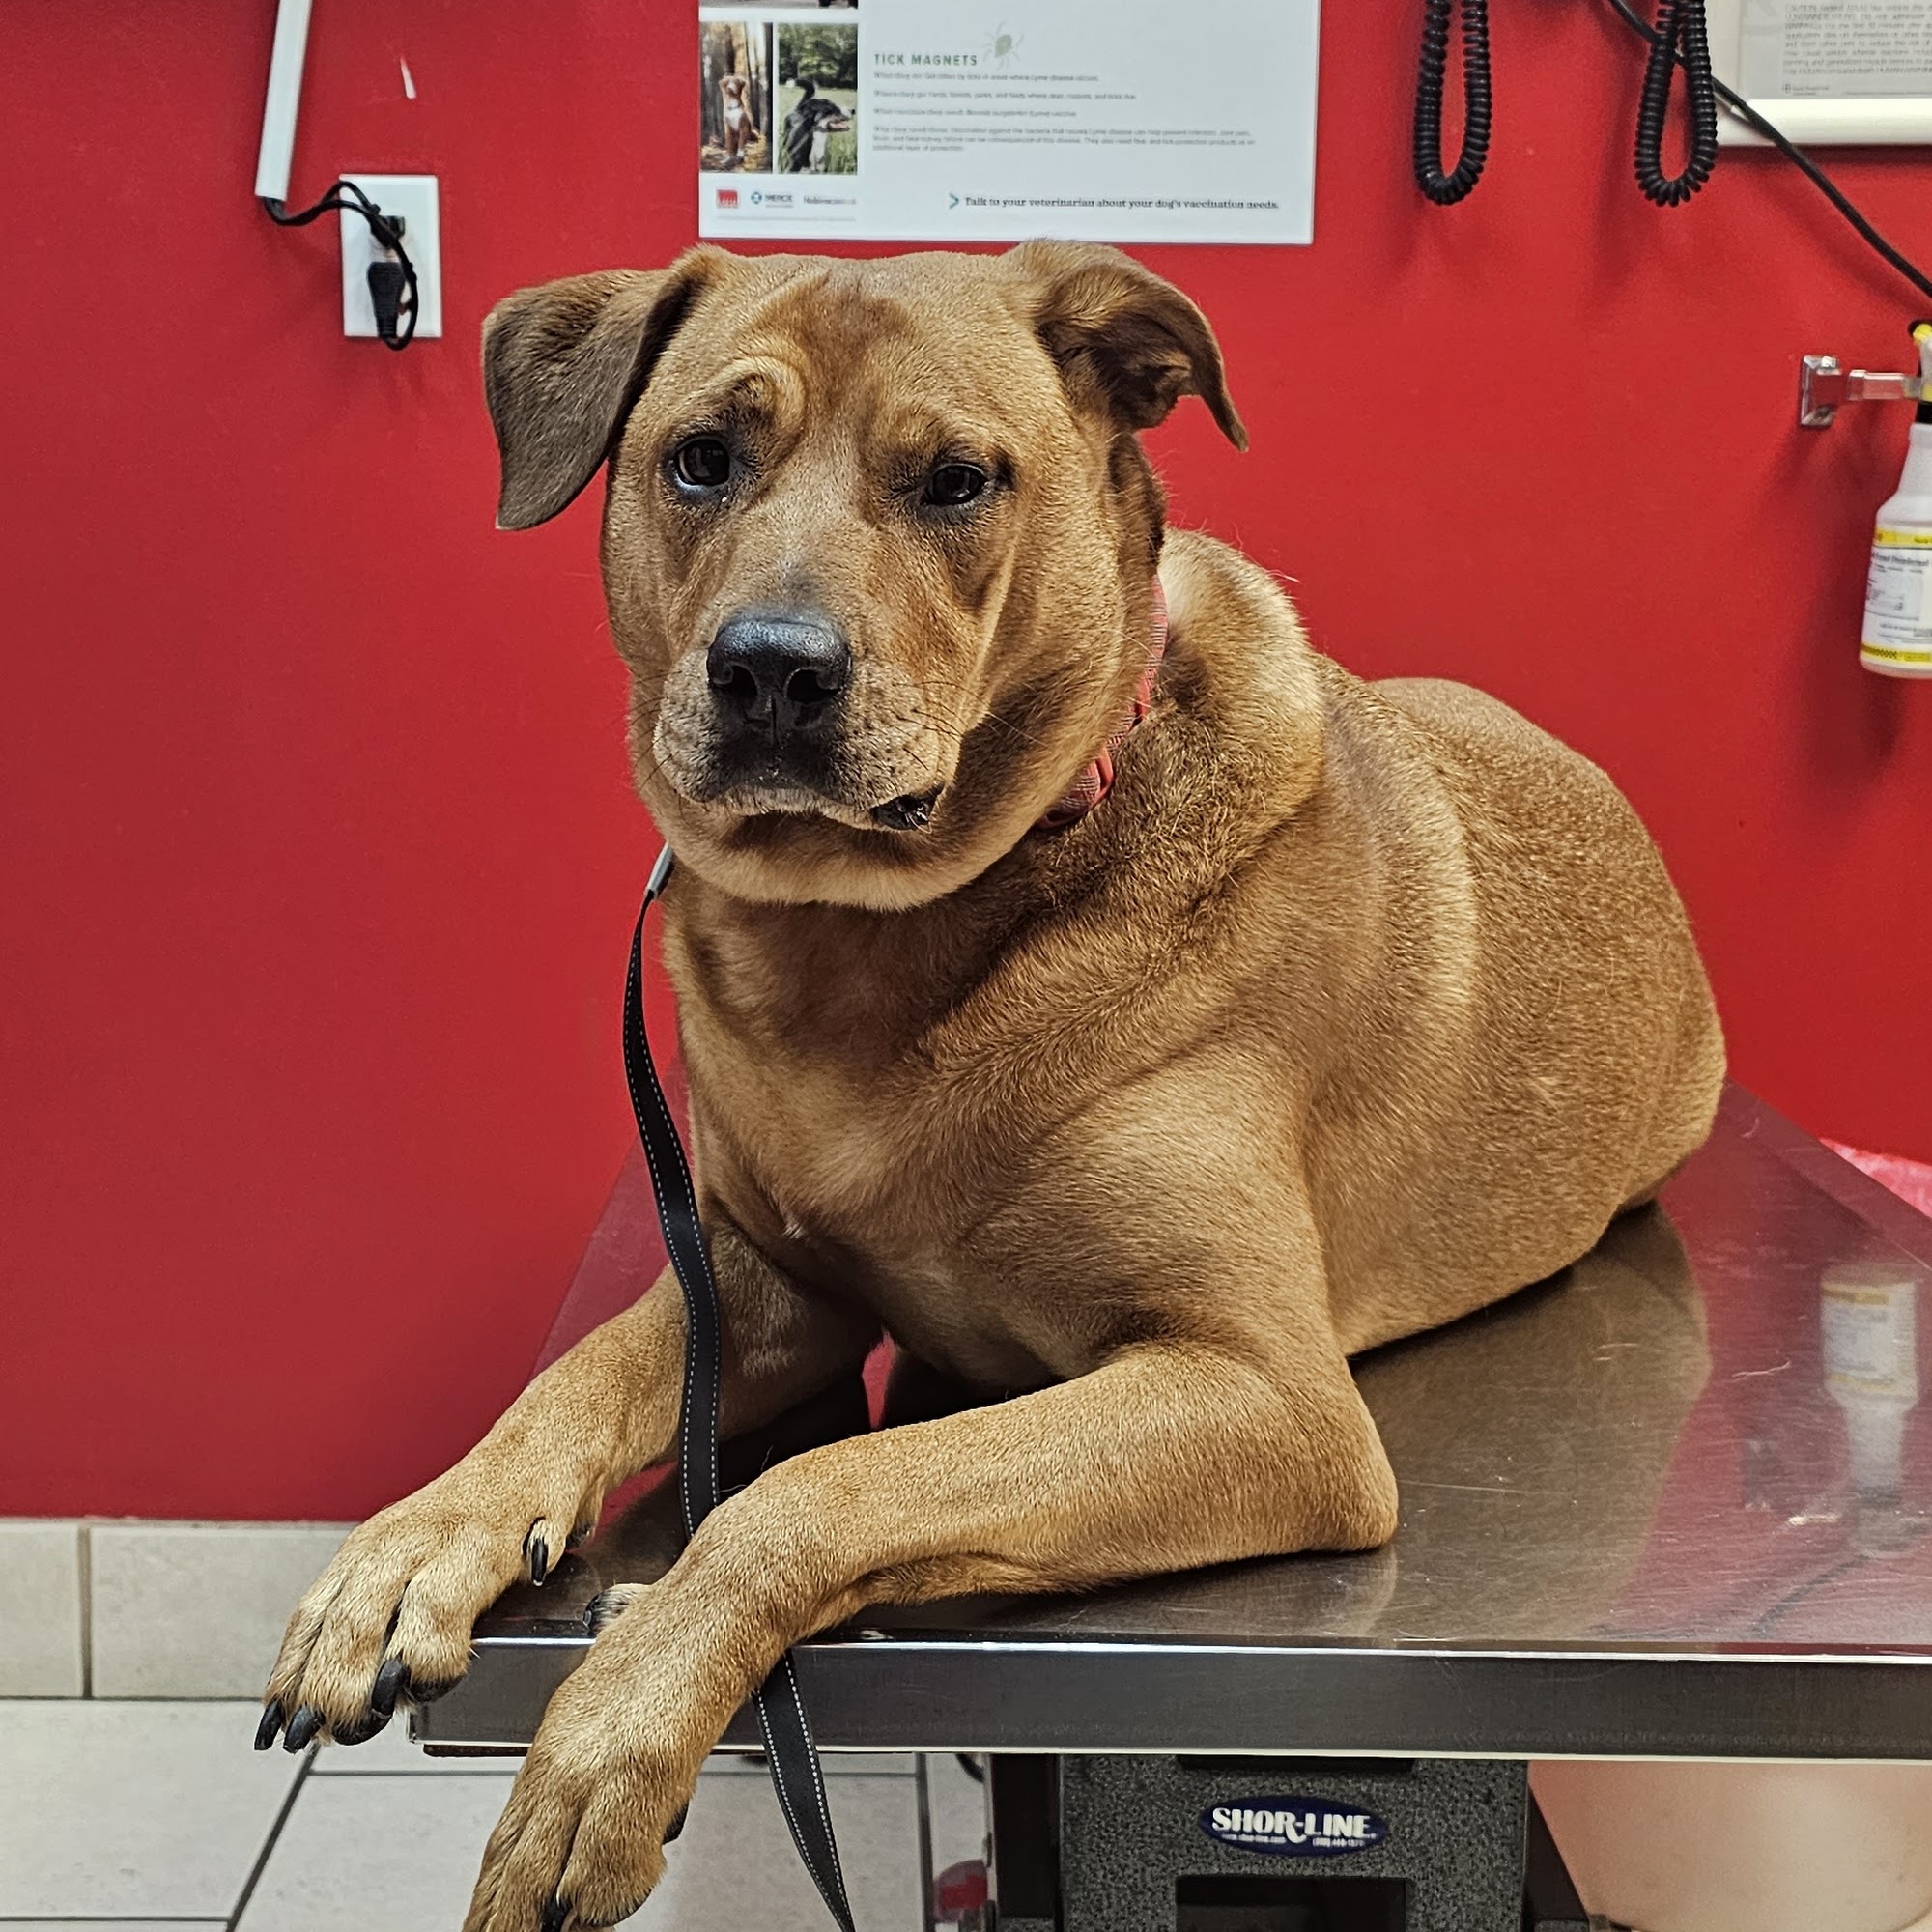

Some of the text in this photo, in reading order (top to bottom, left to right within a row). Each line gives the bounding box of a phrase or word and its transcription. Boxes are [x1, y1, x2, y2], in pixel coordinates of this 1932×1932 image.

[873, 53, 978, 66] TICK MAGNETS
[965, 197, 1279, 210] Talk to your veterinarian about your dog's vaccination needs.
[1211, 1807, 1372, 1844] SHOR-LINE
